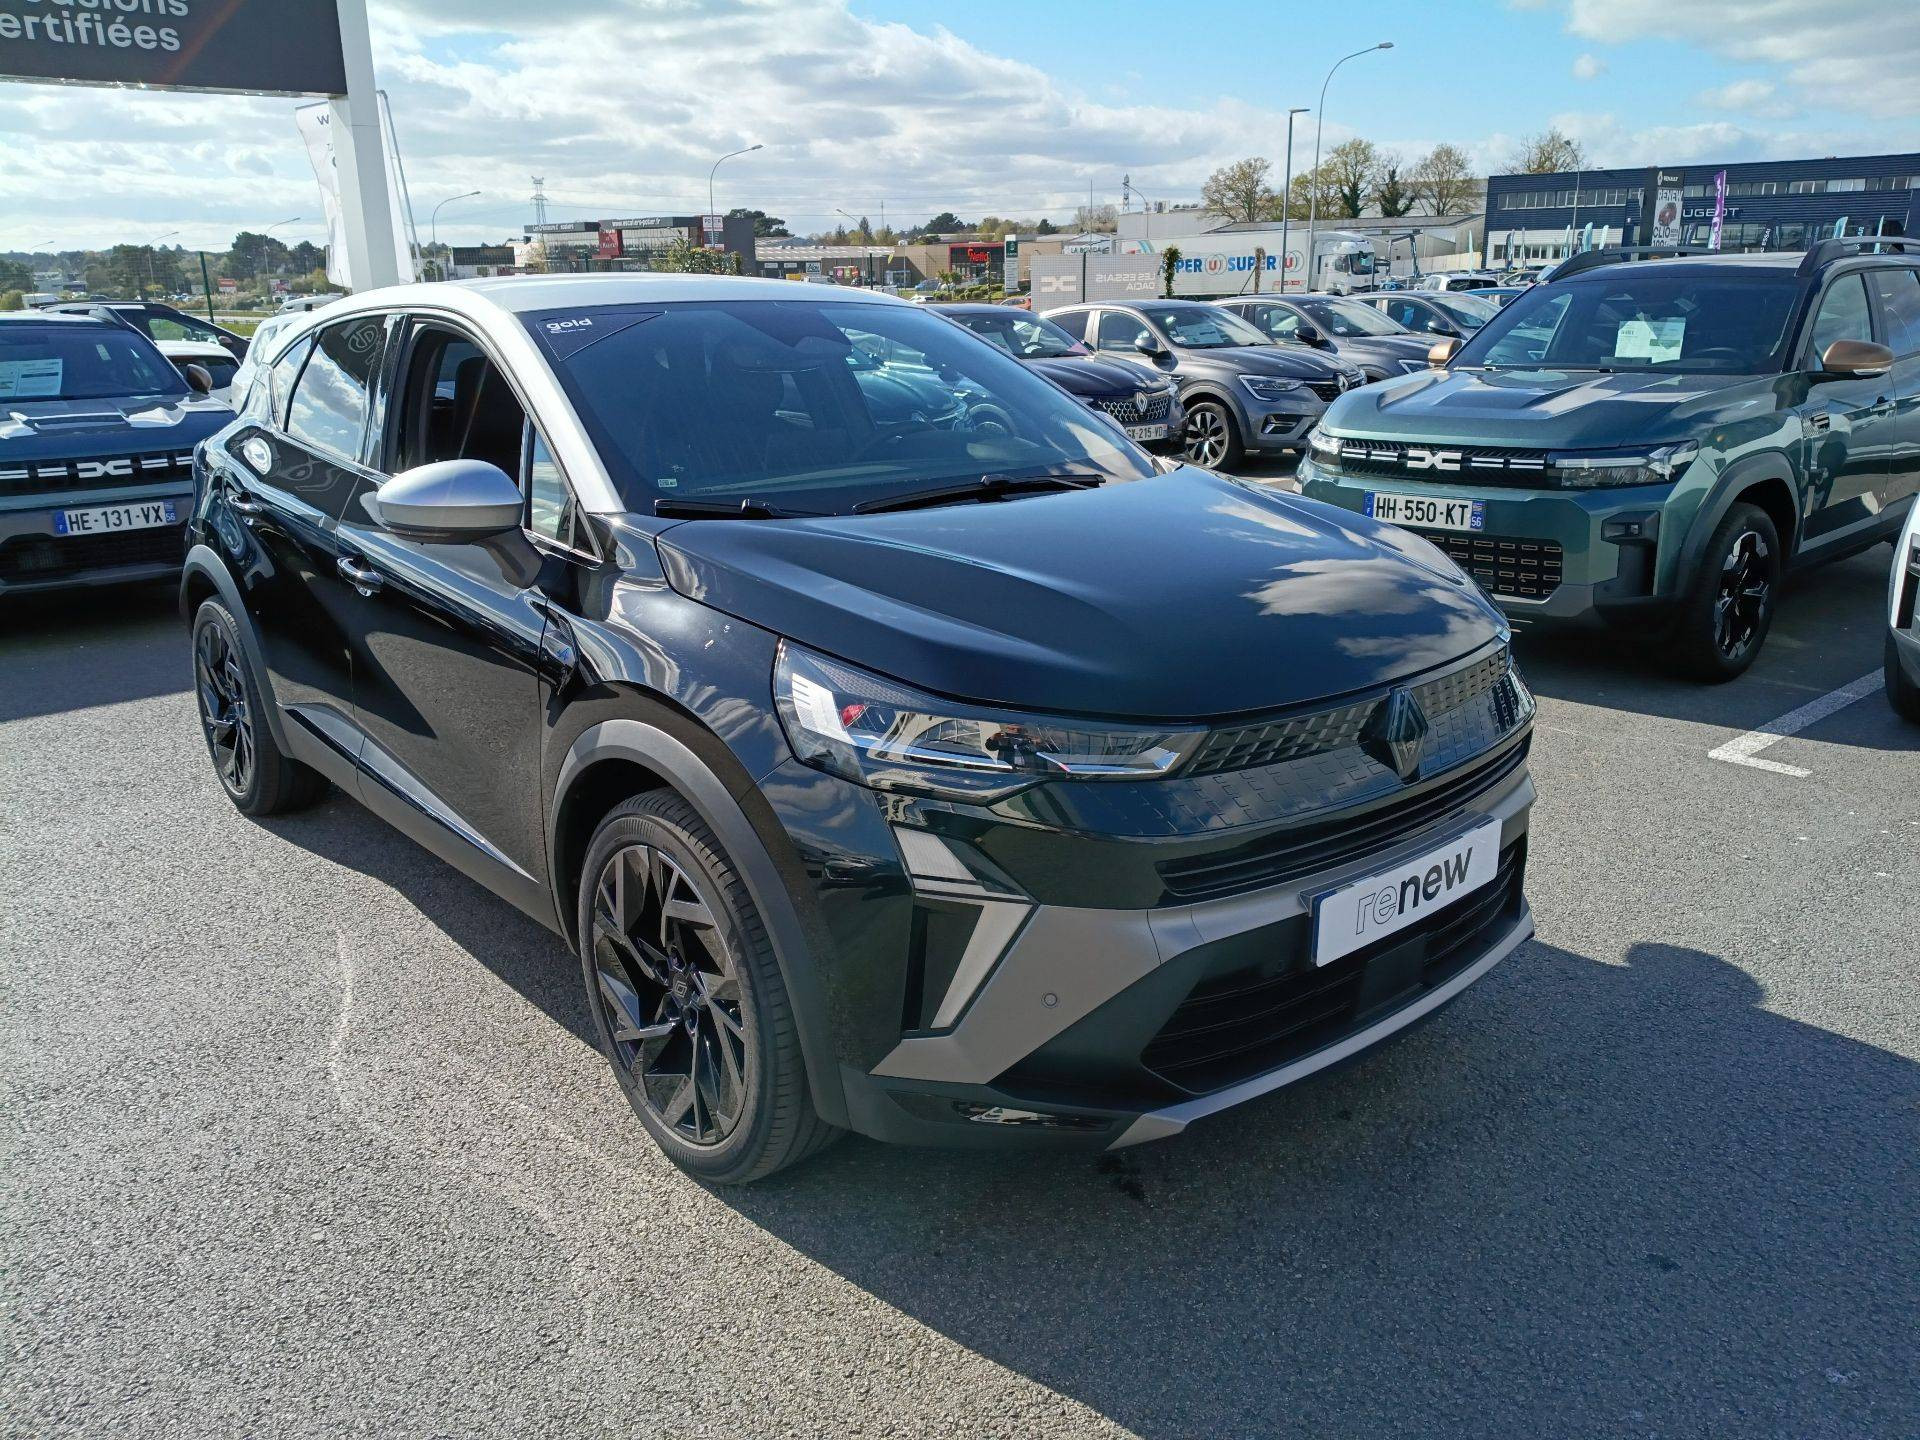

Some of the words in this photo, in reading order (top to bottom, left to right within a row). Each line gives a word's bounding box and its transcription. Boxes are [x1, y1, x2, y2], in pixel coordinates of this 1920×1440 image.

[1657, 189, 1684, 202] RENEW
[1653, 226, 1671, 238] CLIO
[546, 318, 592, 332] gold
[165, 512, 176, 521] 56
[1375, 497, 1469, 526] HH-550-KT
[67, 505, 163, 532] HE-131-VX
[1471, 517, 1482, 527] 56
[1355, 846, 1473, 936] renew
